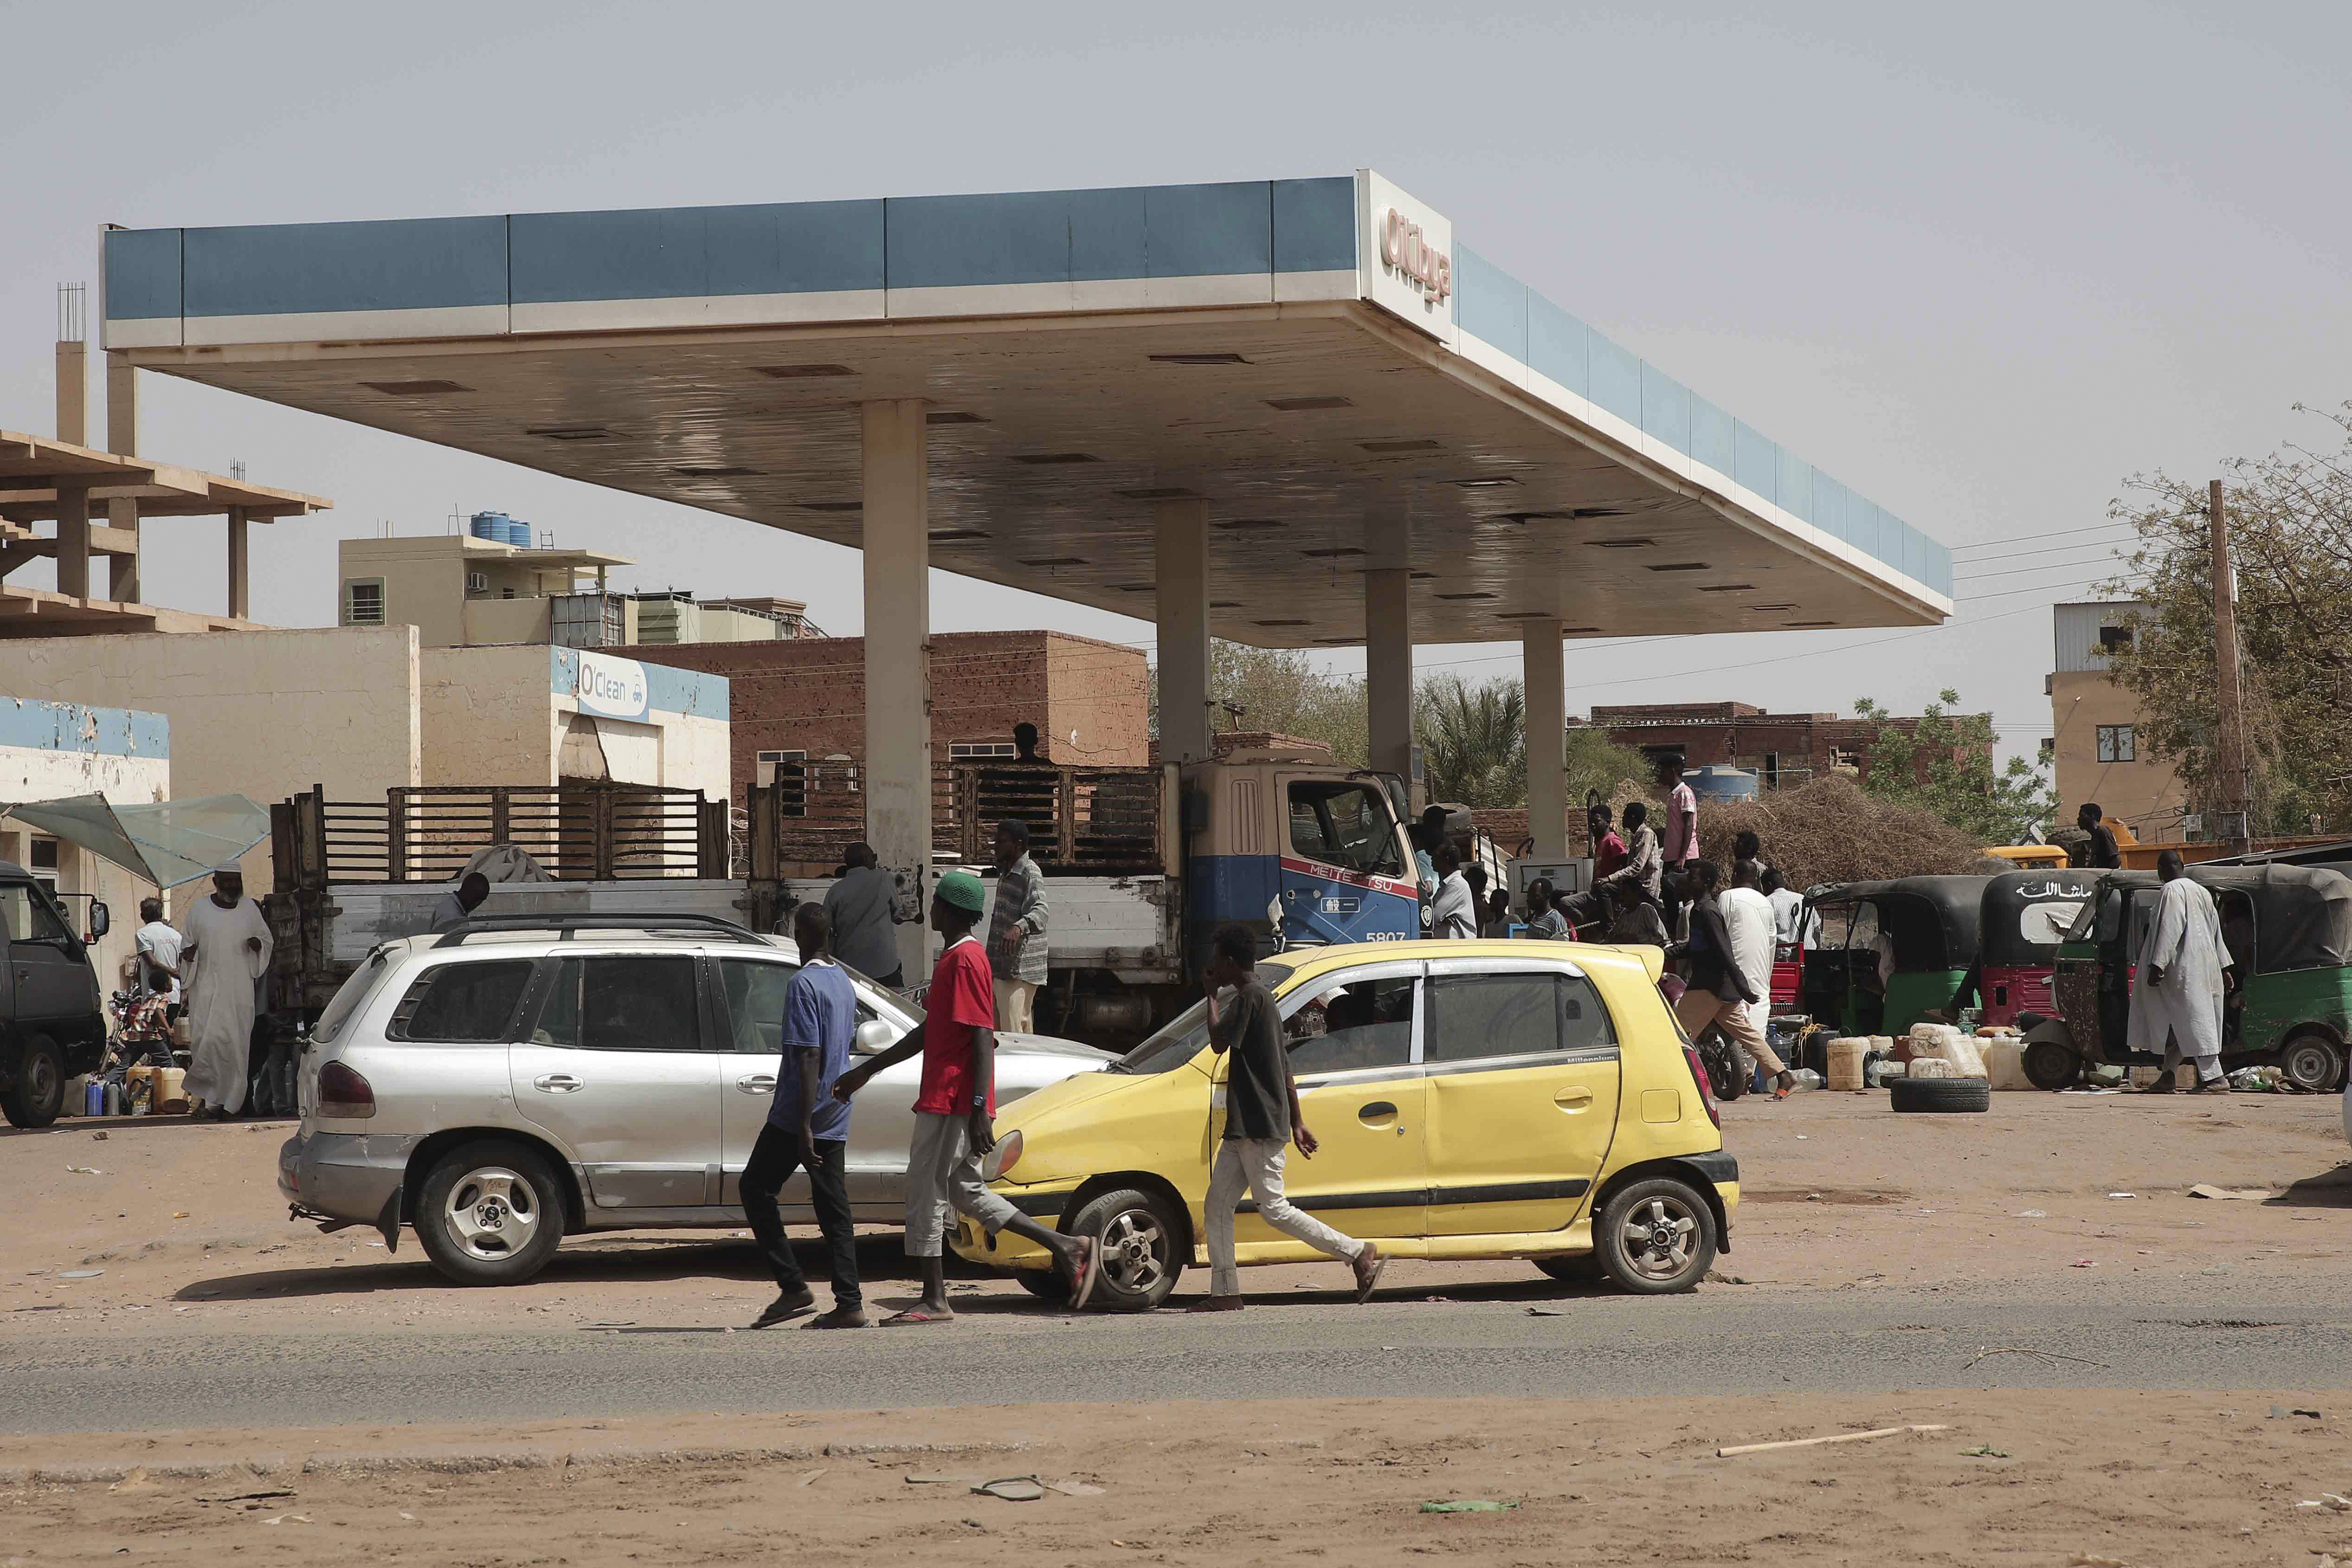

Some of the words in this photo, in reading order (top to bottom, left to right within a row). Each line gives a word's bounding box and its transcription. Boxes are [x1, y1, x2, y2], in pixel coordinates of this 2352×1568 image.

[582, 664, 626, 701] O'Clean
[1366, 931, 1406, 942] 5807
[1567, 1055, 1615, 1064] Millennium
